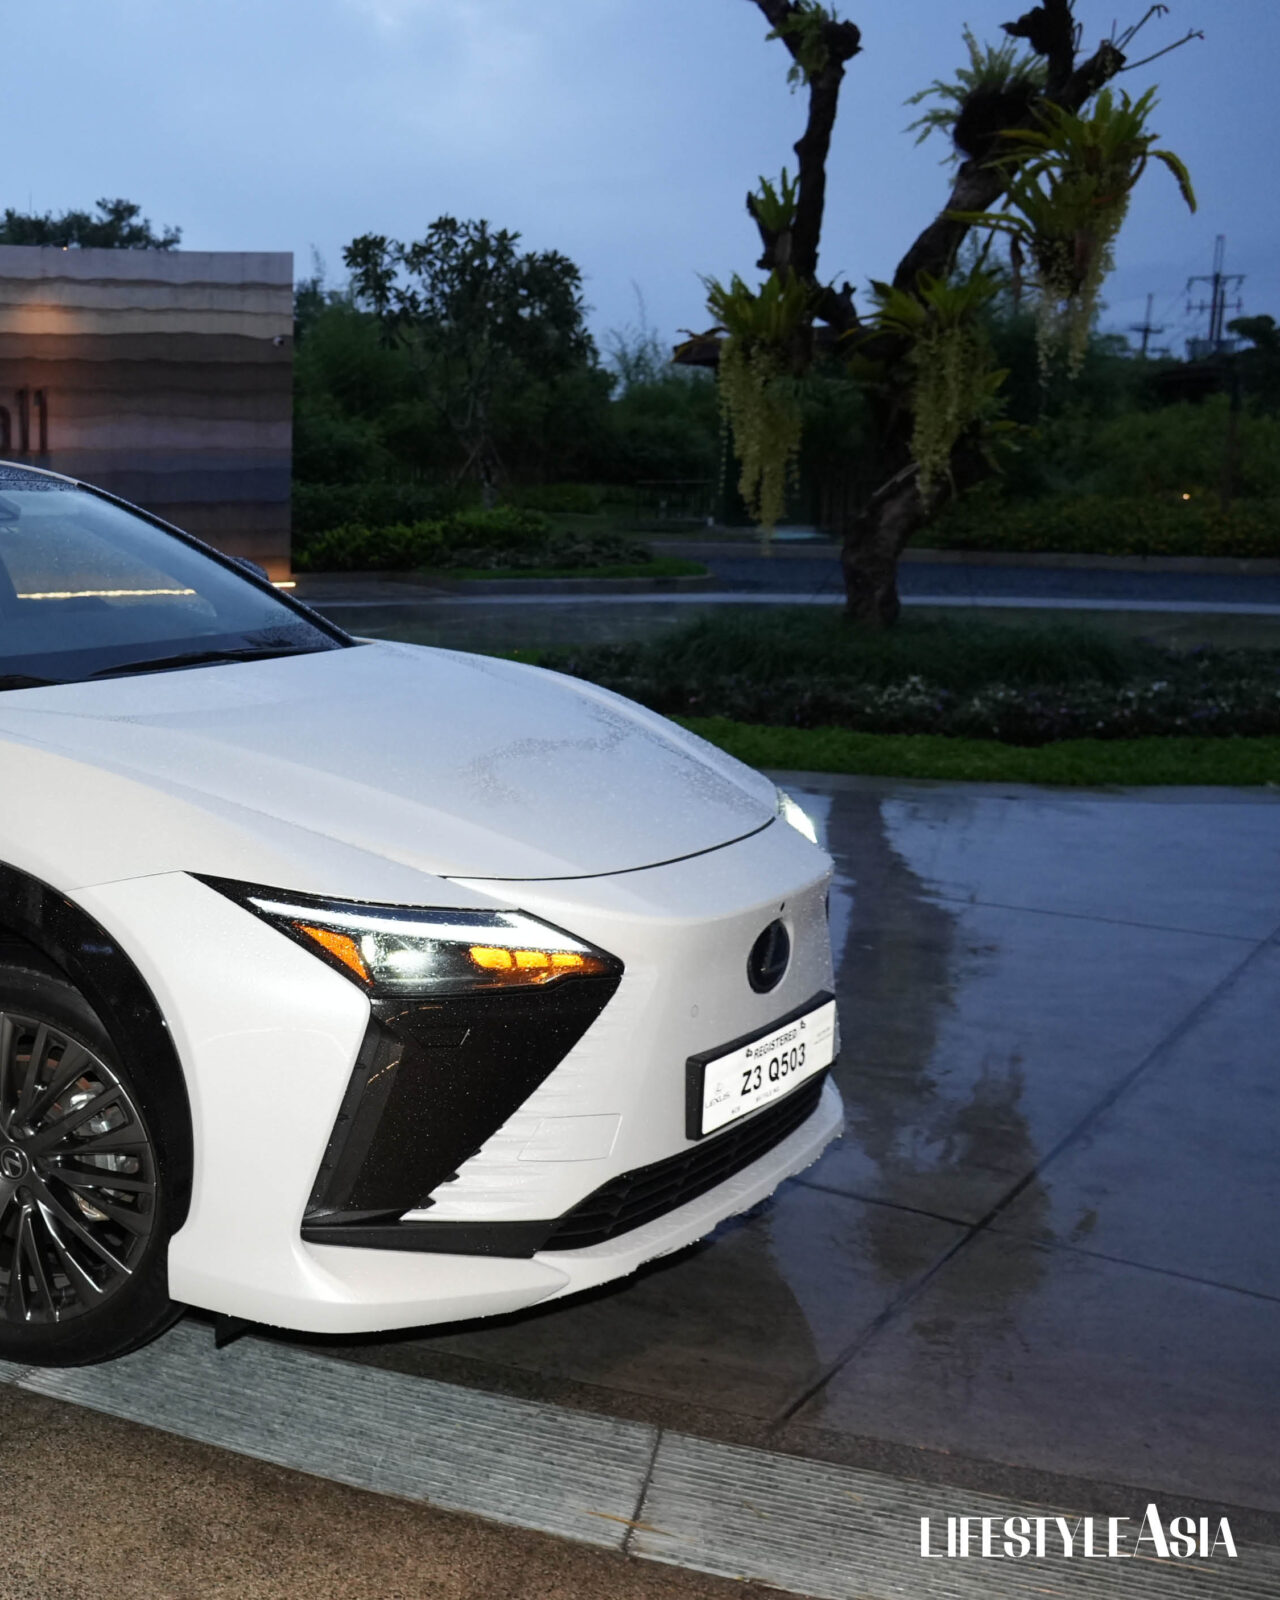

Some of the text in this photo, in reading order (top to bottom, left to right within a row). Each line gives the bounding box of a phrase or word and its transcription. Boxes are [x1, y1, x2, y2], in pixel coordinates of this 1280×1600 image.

[754, 1028, 798, 1059] REGISTERED
[740, 1065, 762, 1096] Z3
[768, 1042, 806, 1082] Q503
